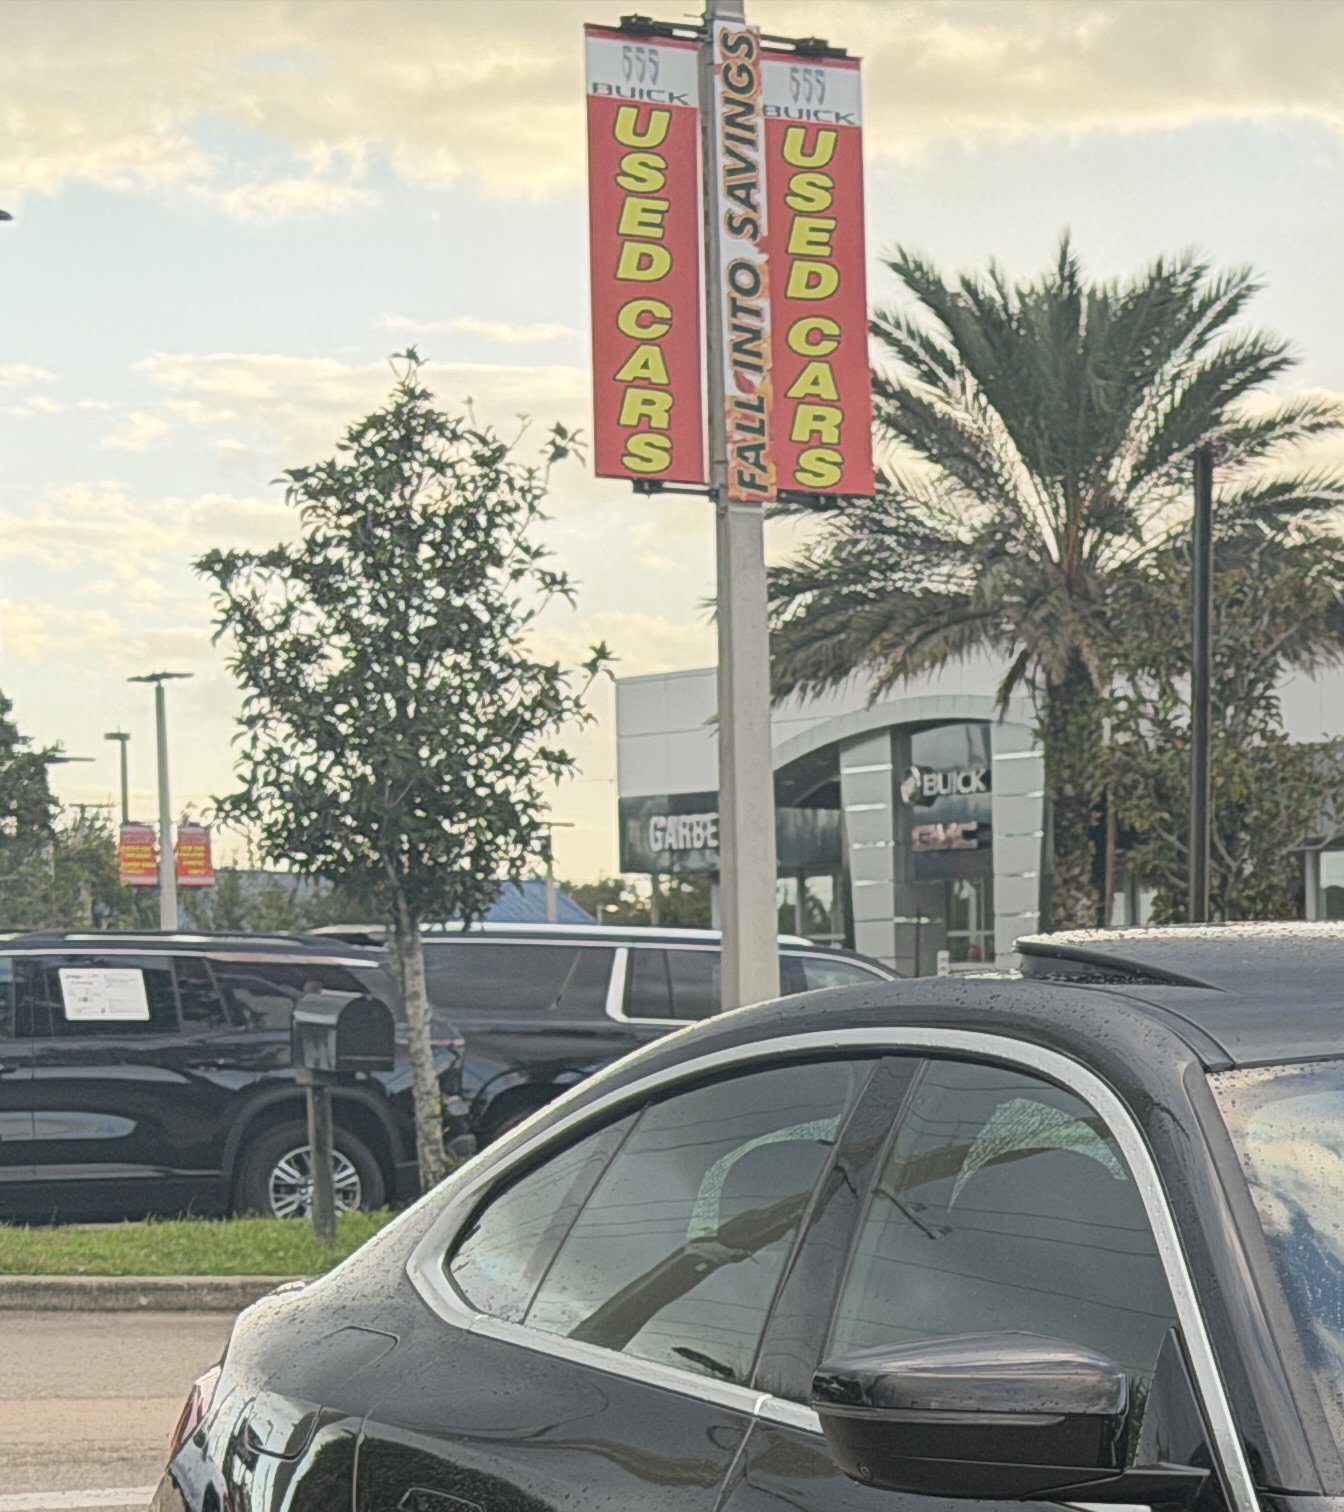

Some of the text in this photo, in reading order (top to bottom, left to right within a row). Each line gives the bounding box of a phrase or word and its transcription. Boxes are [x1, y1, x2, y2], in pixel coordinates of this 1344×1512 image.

[592, 82, 690, 106] BUICK
[762, 104, 856, 126] BUICK
[720, 30, 770, 494] FALL INTO SAVINGS
[613, 105, 673, 475] USED CARS
[781, 125, 844, 488] USED CARS
[922, 768, 988, 797] BUICK
[649, 812, 719, 852] GARBE
[912, 821, 978, 852] GMC
